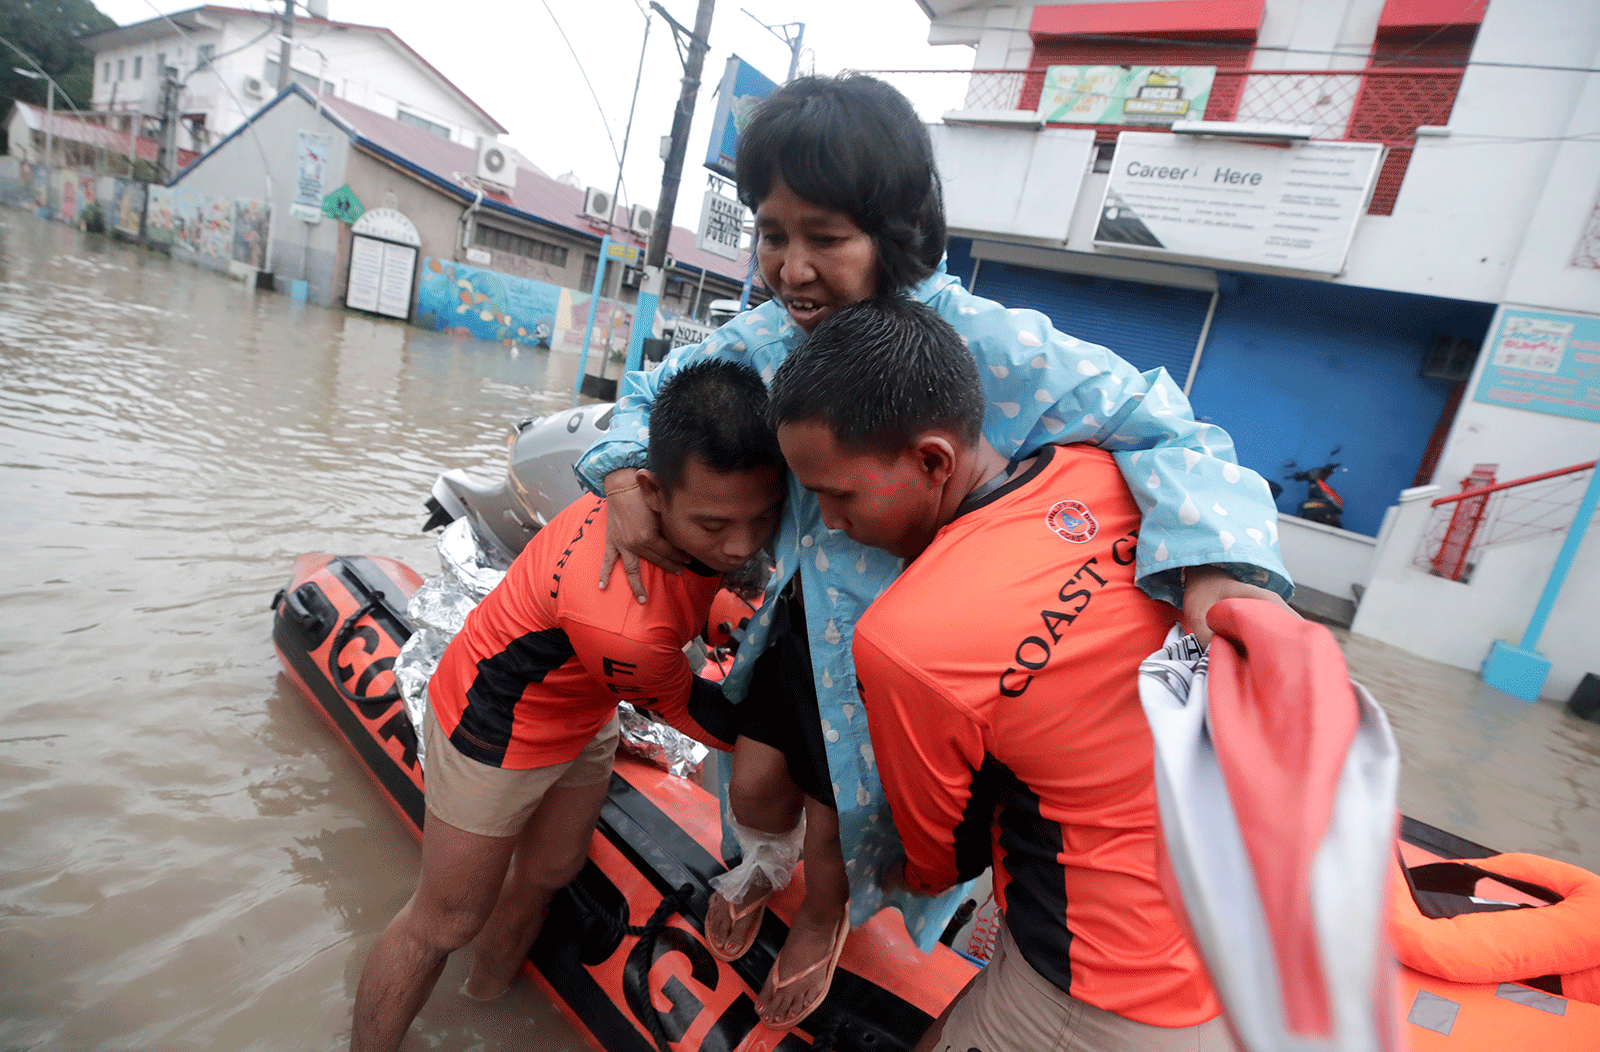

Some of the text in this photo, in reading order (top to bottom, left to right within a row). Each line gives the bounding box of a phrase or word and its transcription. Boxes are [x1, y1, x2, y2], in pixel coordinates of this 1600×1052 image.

[1126, 161, 1190, 180] Career
[1213, 167, 1263, 186] Here
[711, 198, 743, 217] NOTARY
[705, 226, 738, 249] PUBLIC
[550, 498, 606, 599] UARD
[1000, 558, 1108, 698] COAST
